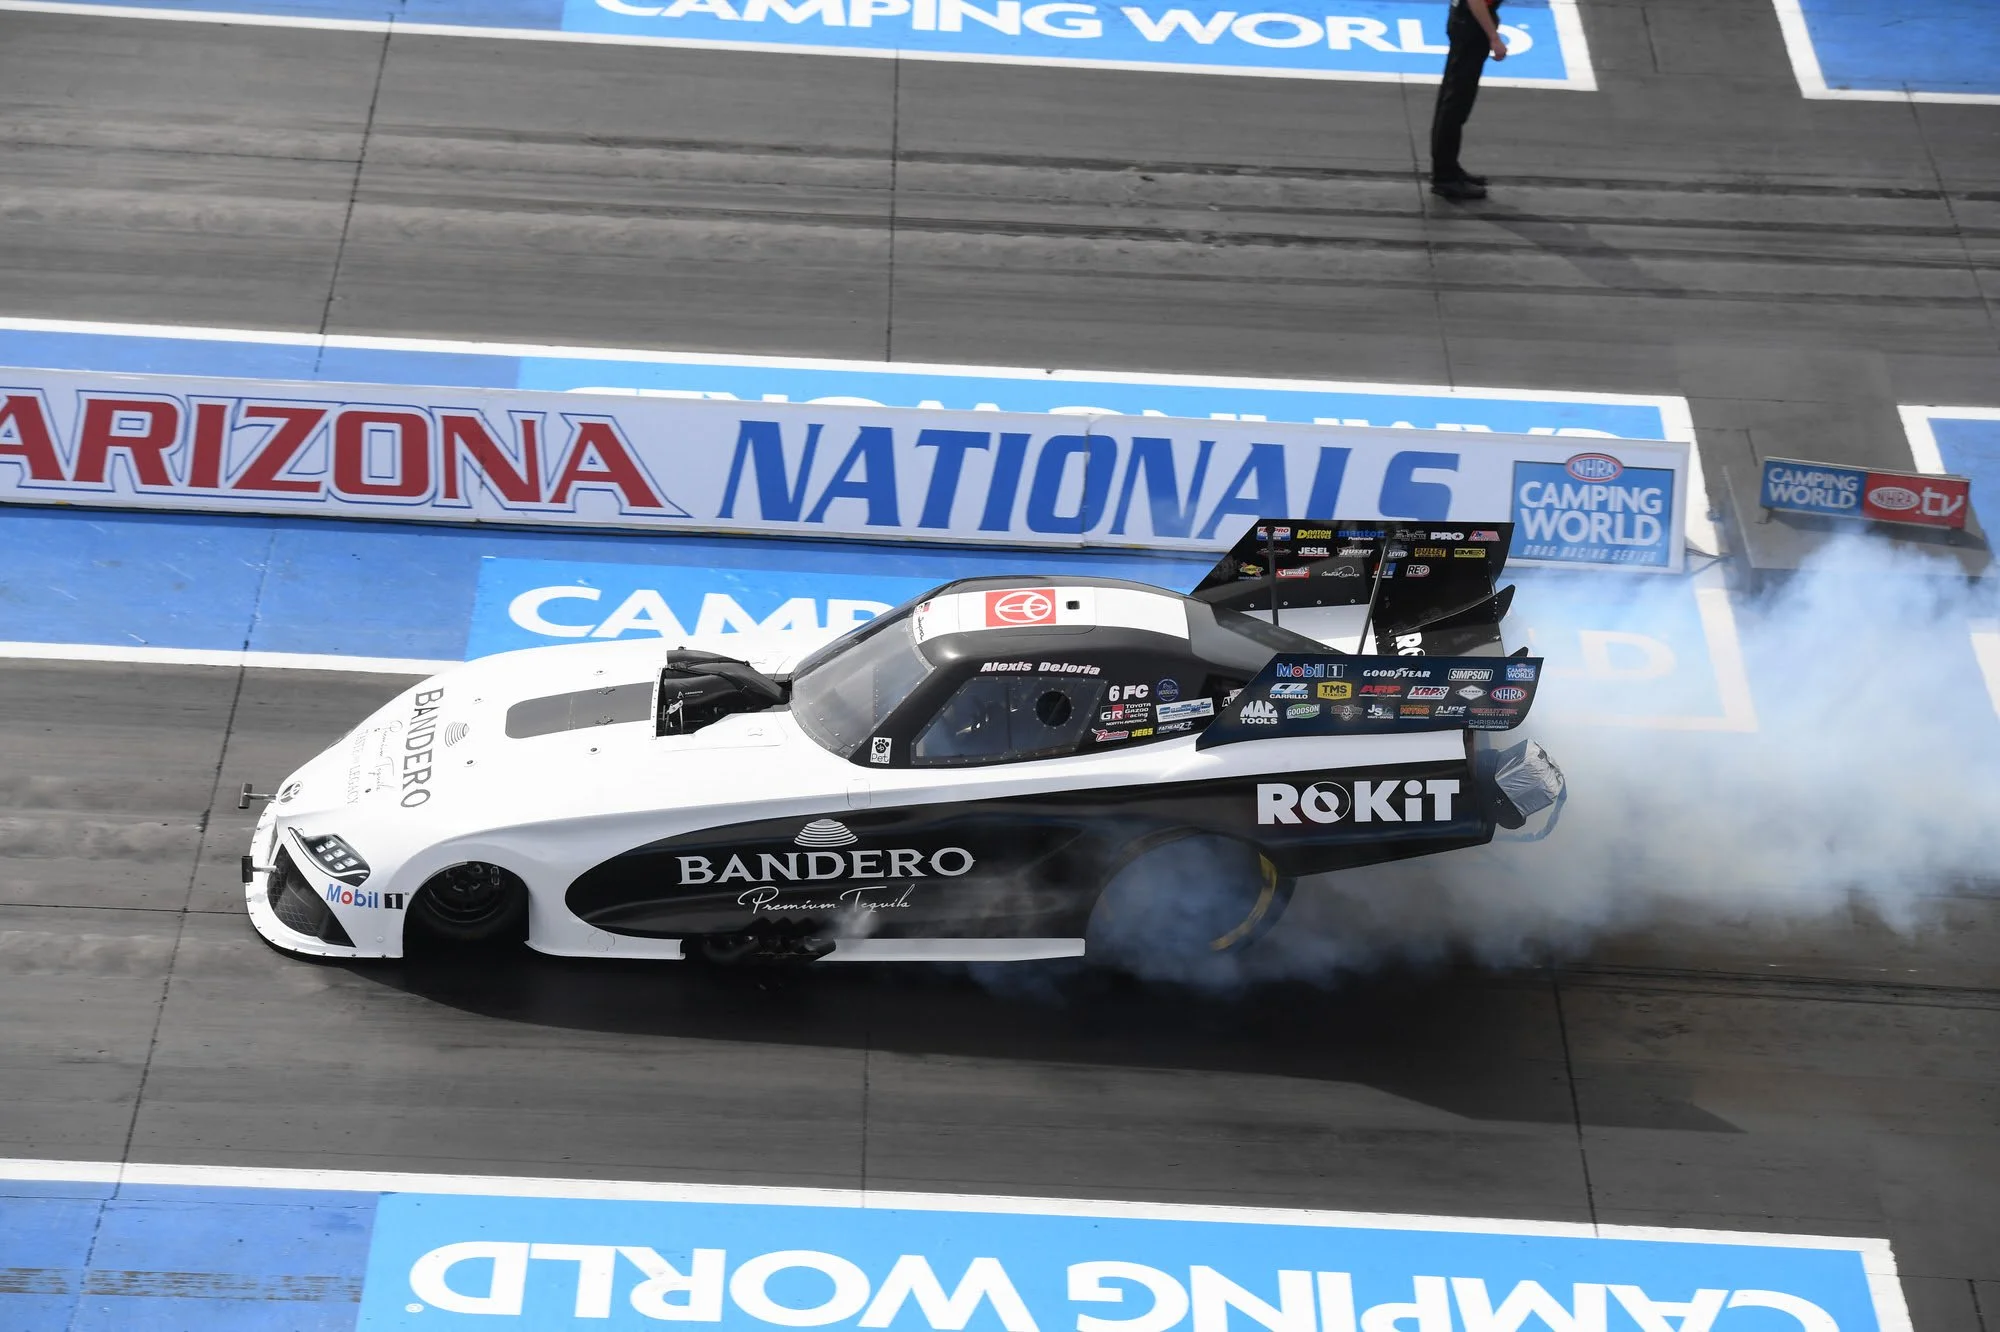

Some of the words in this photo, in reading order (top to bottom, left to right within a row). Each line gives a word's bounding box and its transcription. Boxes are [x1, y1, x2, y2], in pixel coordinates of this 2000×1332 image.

[0, 388, 688, 516] ARIZONA
[715, 419, 1461, 541] NATIONALS
[1571, 457, 1619, 479] NHRA
[1768, 467, 1859, 492] CAMPING
[1519, 481, 1663, 515] CAMPING
[1768, 482, 1857, 509] WORLD
[1430, 531, 1465, 540] PRO
[1519, 508, 1662, 546] WORLD
[1297, 547, 1330, 555] JESEL
[1523, 544, 1557, 556] DRAG
[1560, 546, 1606, 560] RACING
[1612, 549, 1657, 562] SERIES
[508, 584, 896, 640] CAMP
[980, 662, 1033, 673] Alexis
[1038, 662, 1101, 676] DeJoria
[1276, 663, 1325, 678] Mobil
[1363, 667, 1431, 679] GOODYEAR
[1450, 669, 1490, 680] SIMPSON
[1109, 685, 1120, 702] 6
[1123, 684, 1149, 700] FC
[1322, 685, 1347, 694] TMS
[1410, 687, 1441, 695] XRP
[1493, 687, 1524, 701] NHRA
[1101, 710, 1123, 720] GR
[1240, 700, 1278, 718] MAC
[1287, 705, 1320, 716] GOODSON
[1435, 705, 1467, 714] AJPE
[1131, 728, 1153, 737] JEGS
[400, 687, 444, 808] BANDERO
[871, 753, 889, 763] Pet
[675, 847, 976, 885] BANDERO
[326, 883, 379, 909] Mobil
[386, 893, 402, 909] 1
[737, 886, 838, 914] Premium
[839, 884, 916, 913] Tequila
[409, 1241, 1042, 1332] WORLD
